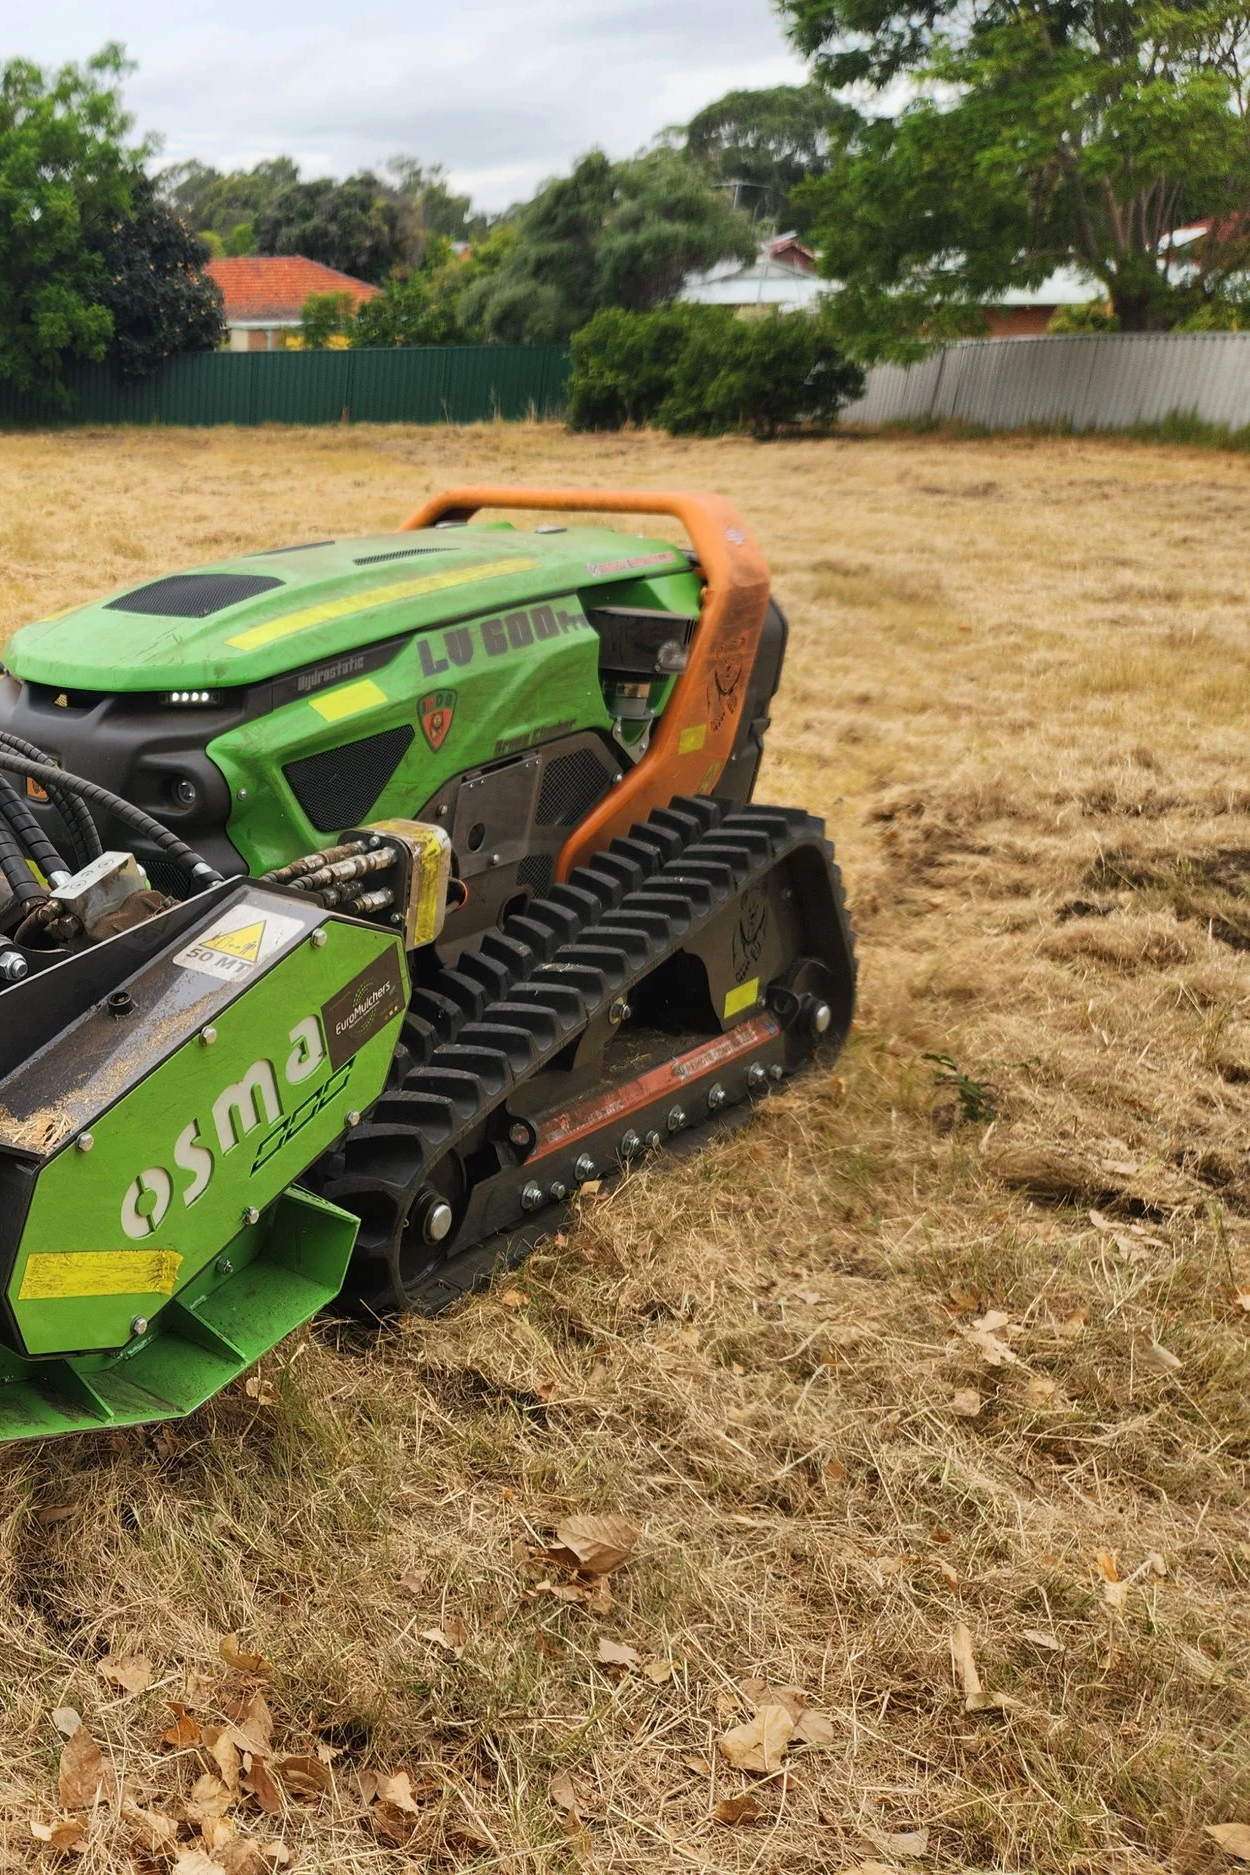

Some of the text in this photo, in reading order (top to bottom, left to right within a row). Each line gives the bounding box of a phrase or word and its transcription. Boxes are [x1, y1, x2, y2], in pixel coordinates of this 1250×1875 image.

[416, 627, 474, 678] LV
[479, 605, 560, 657] 600
[297, 656, 364, 692] Hydrostatic
[186, 948, 252, 973] 50 MT
[335, 980, 391, 1035] EuroMulchers
